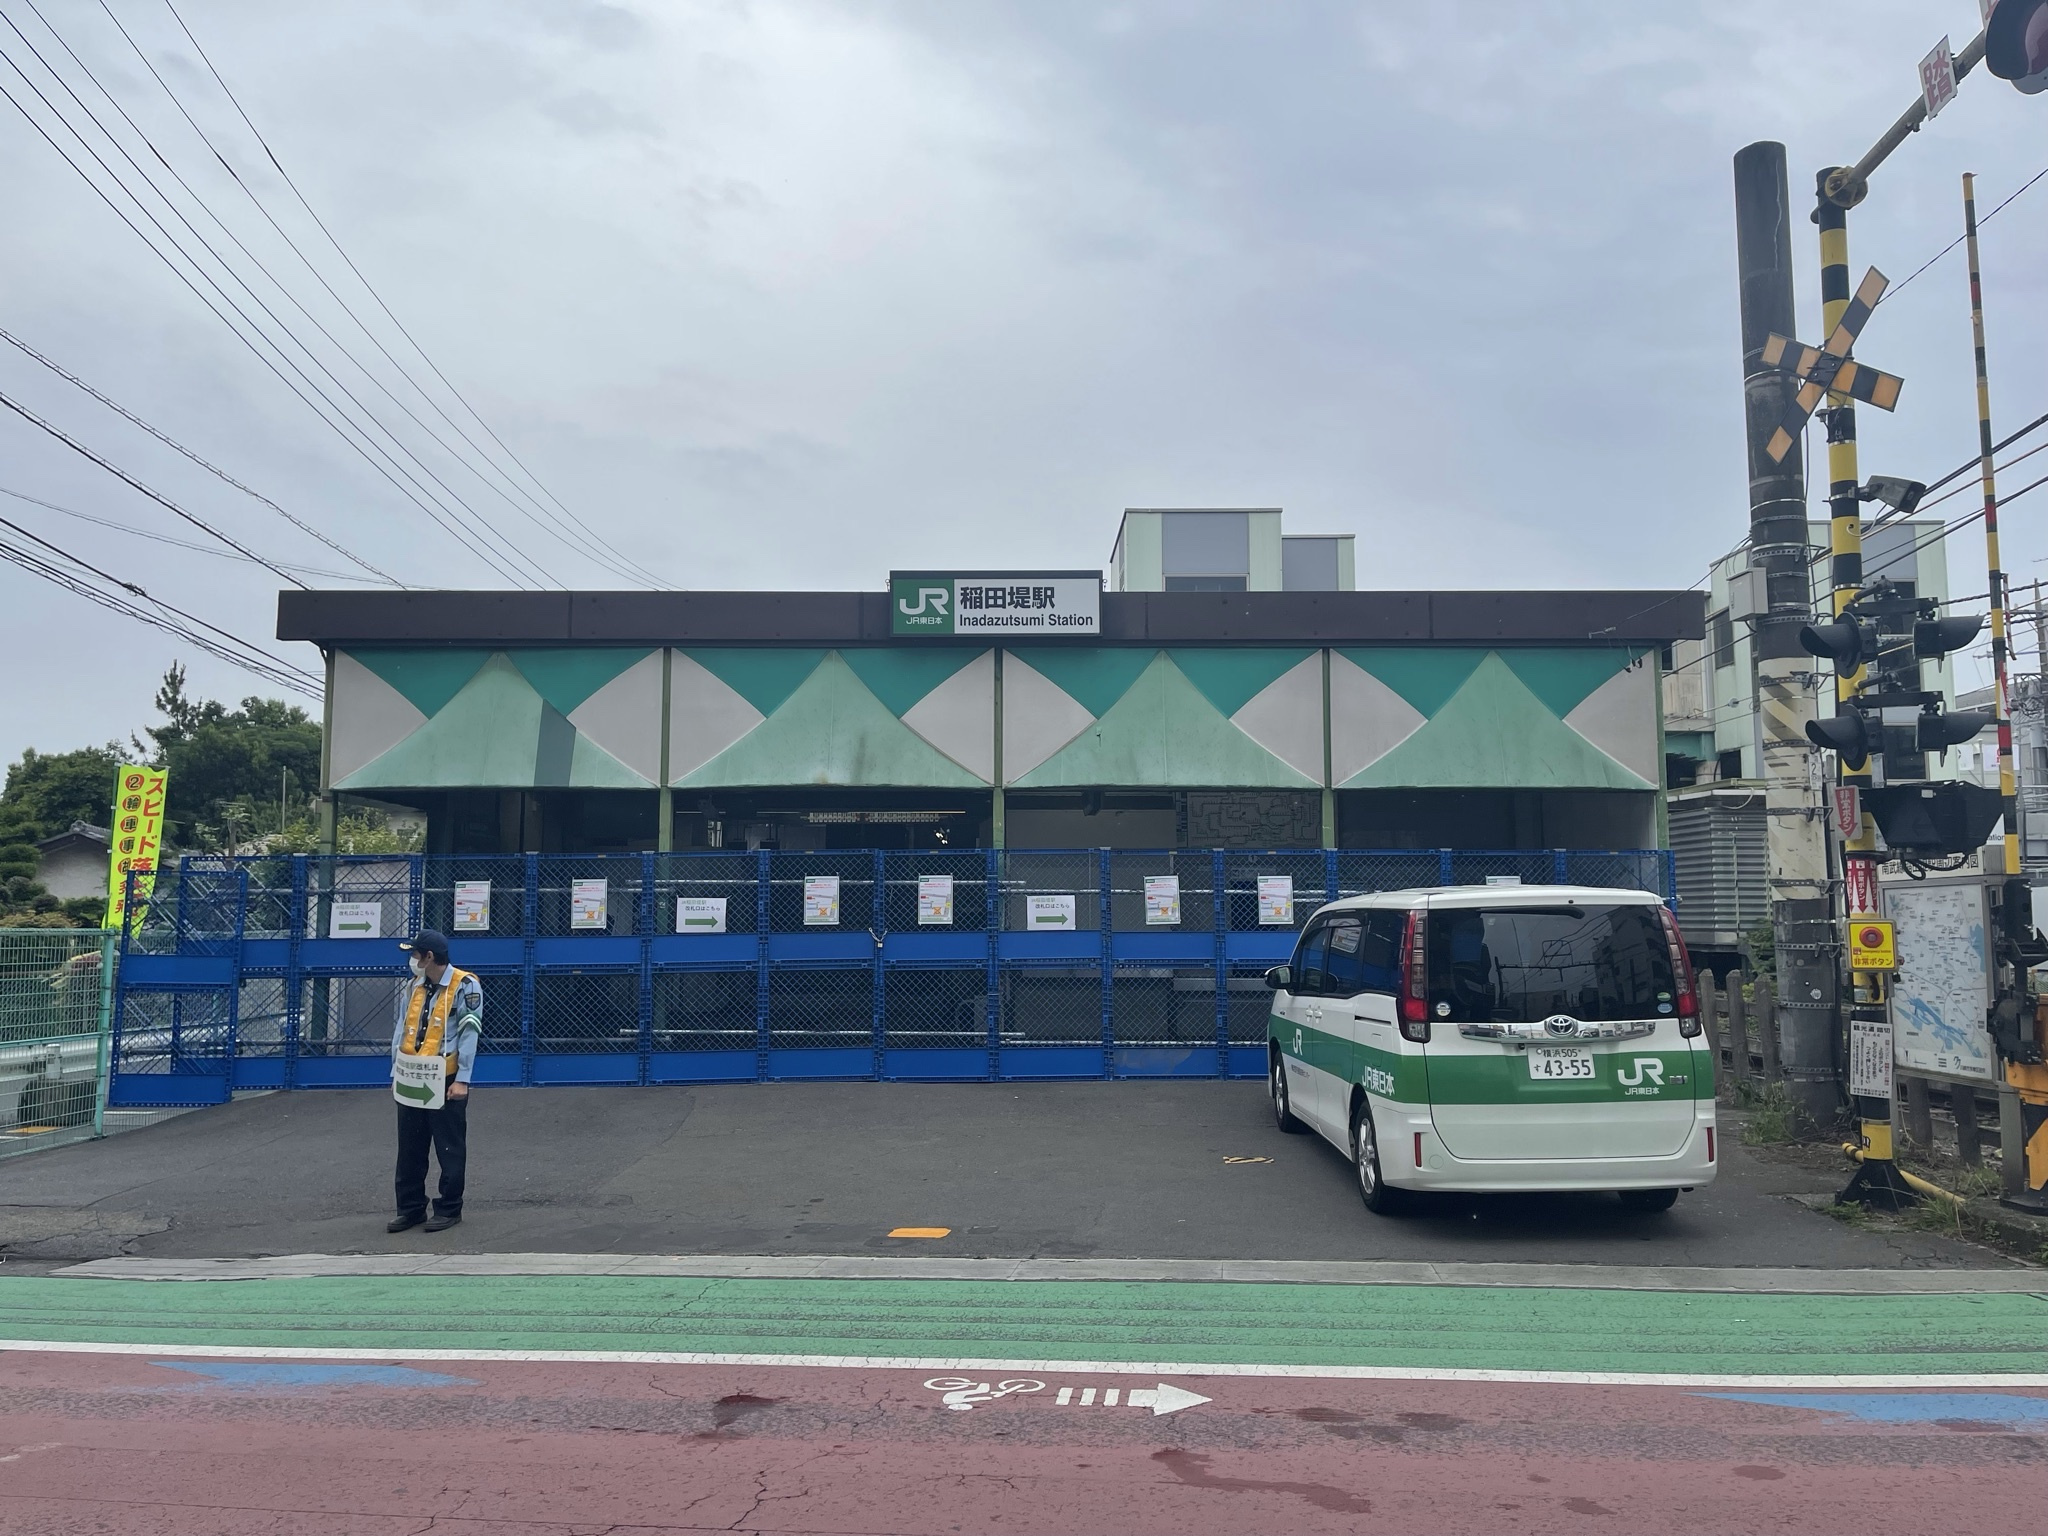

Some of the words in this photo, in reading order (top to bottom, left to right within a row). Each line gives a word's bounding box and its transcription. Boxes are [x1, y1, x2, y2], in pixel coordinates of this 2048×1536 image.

[1922, 49, 1953, 112] 踏
[899, 587, 949, 615] JR
[960, 586, 1055, 610] 稲田堤駅
[906, 616, 943, 625] JR東日本
[960, 613, 1044, 627] Inadazutsumi
[1048, 613, 1093, 626] Station
[1839, 790, 1853, 832] 非常ボタン
[1853, 957, 1893, 966] 非常ボタン
[1292, 1028, 1303, 1056] JR
[1361, 1065, 1396, 1096] JR東日本
[1544, 1059, 1591, 1077] 43-55
[1617, 1057, 1665, 1086] JR
[1624, 1087, 1660, 1096] JR東日本
